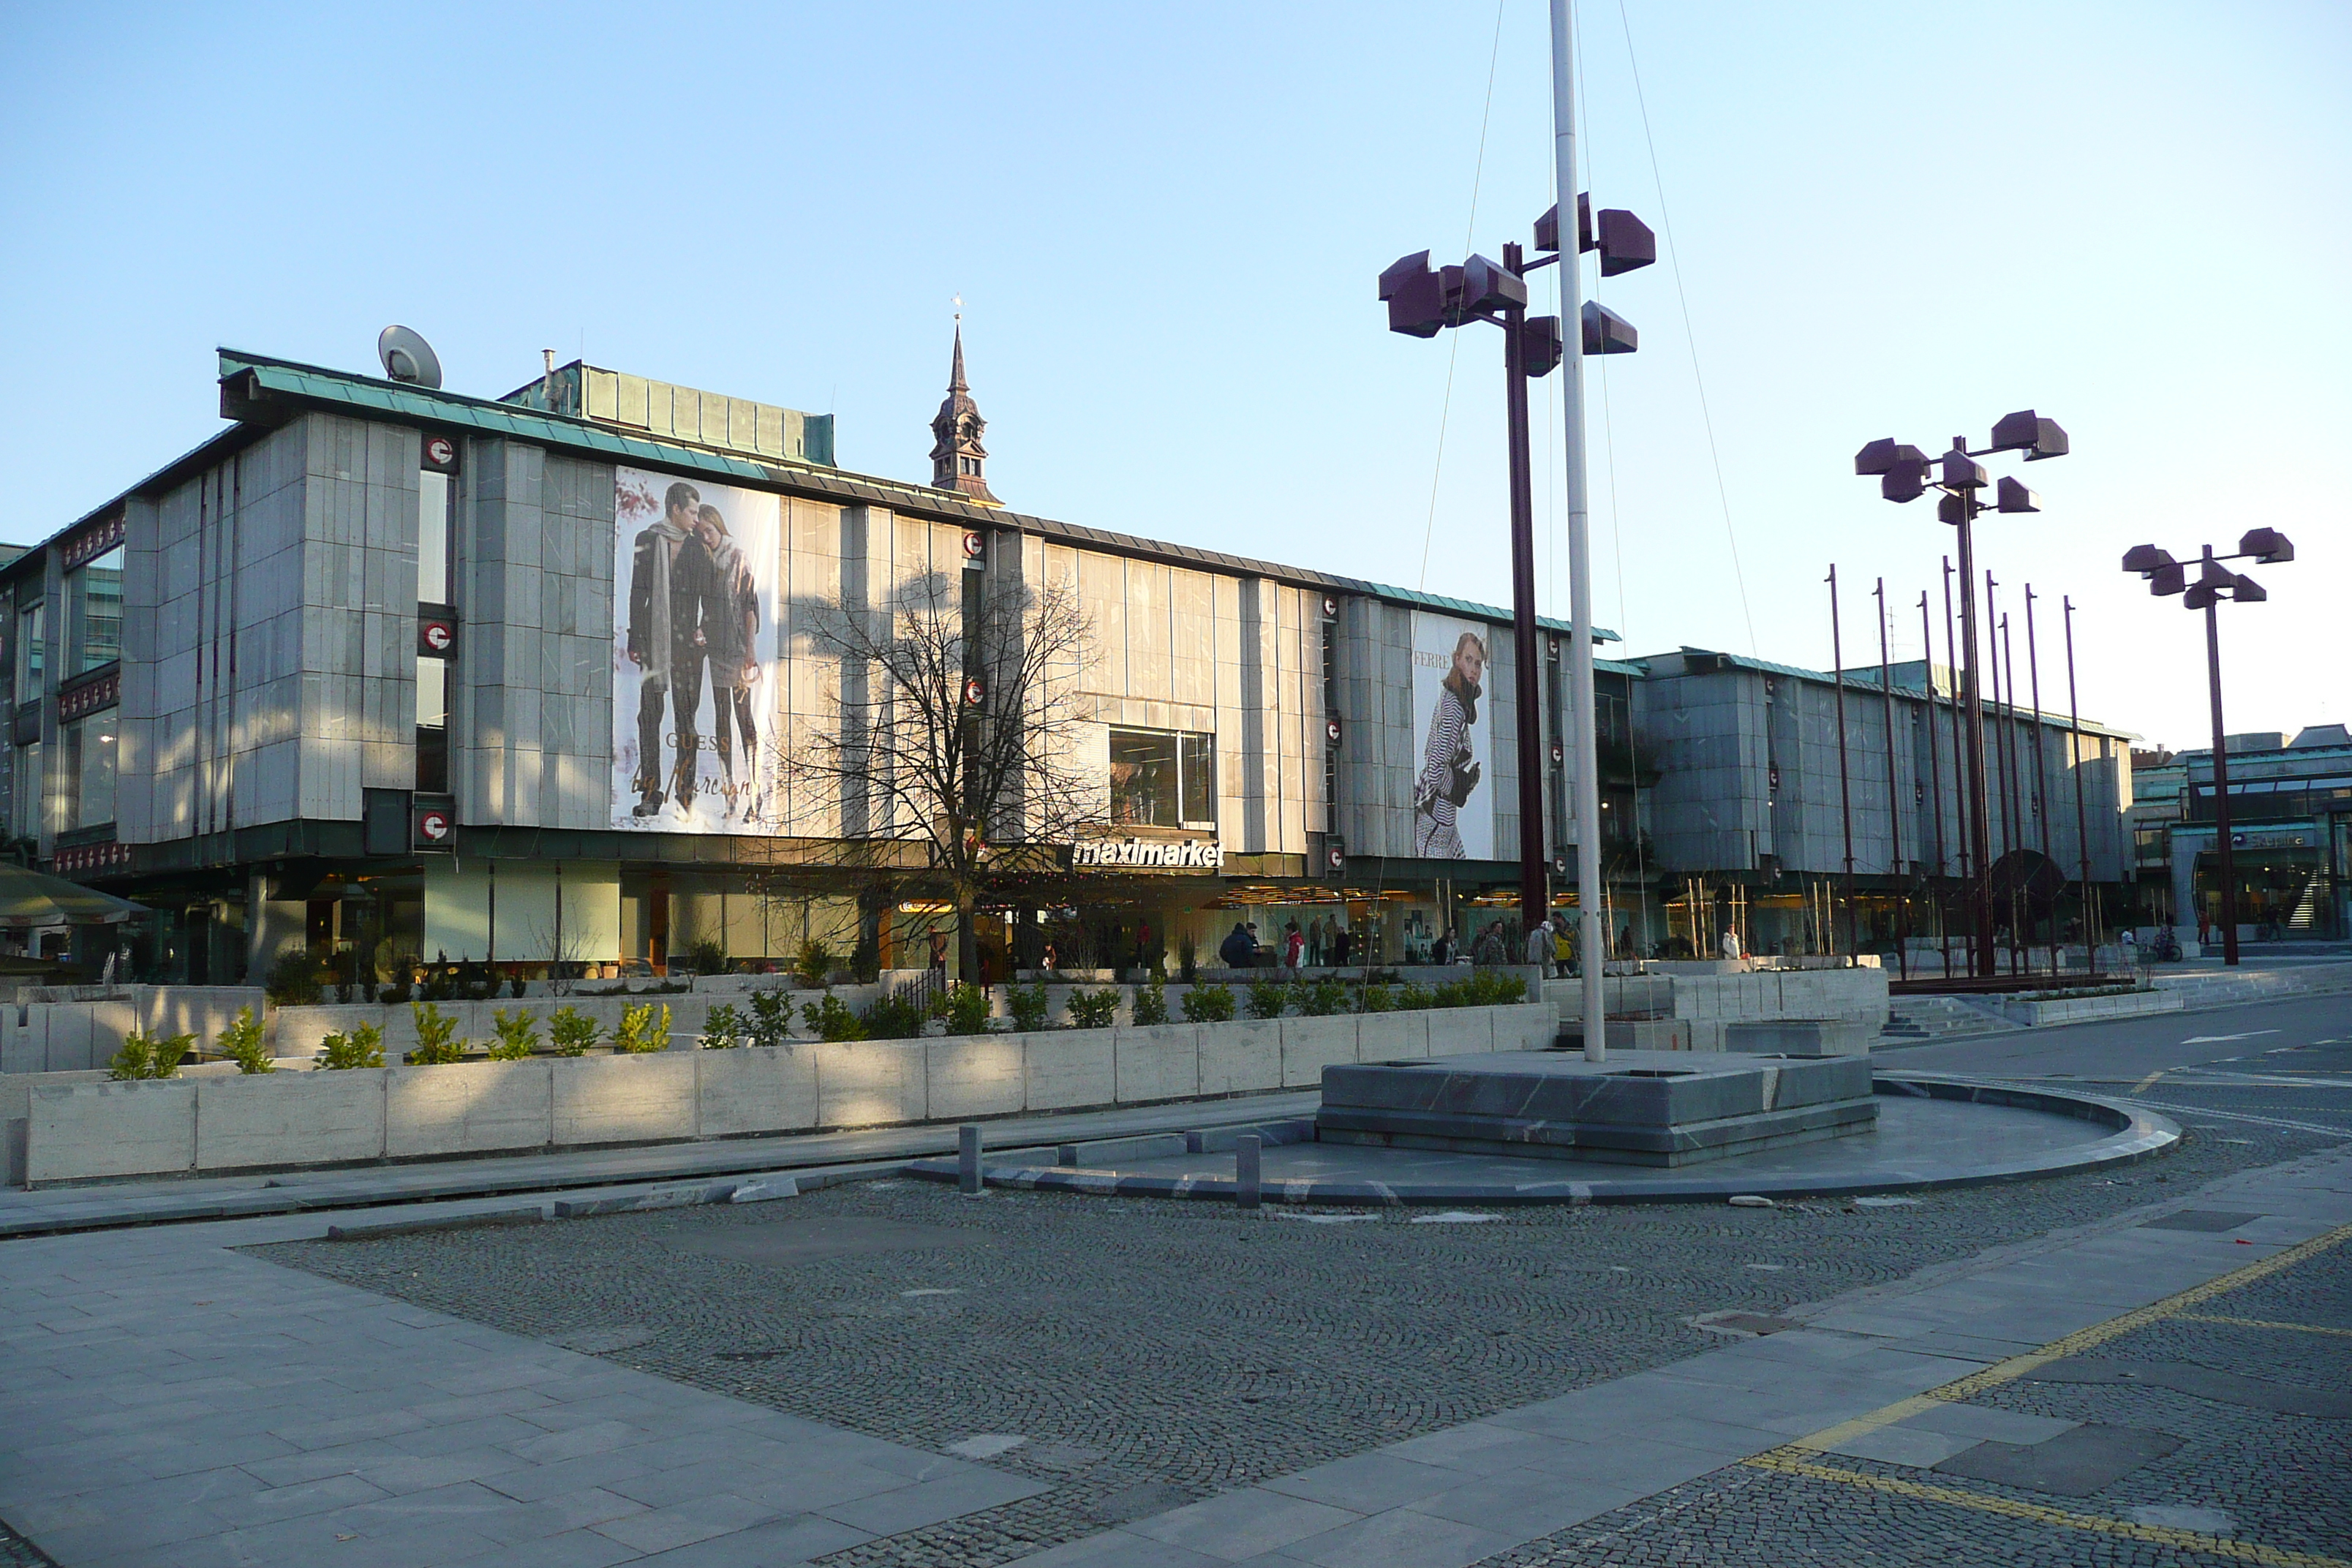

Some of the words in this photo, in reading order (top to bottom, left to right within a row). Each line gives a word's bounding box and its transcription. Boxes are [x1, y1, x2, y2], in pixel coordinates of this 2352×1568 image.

[1414, 649, 1450, 670] FERRE
[666, 732, 730, 753] GUESS
[664, 758, 759, 807] Marcian
[1072, 837, 1226, 867] maximarket
